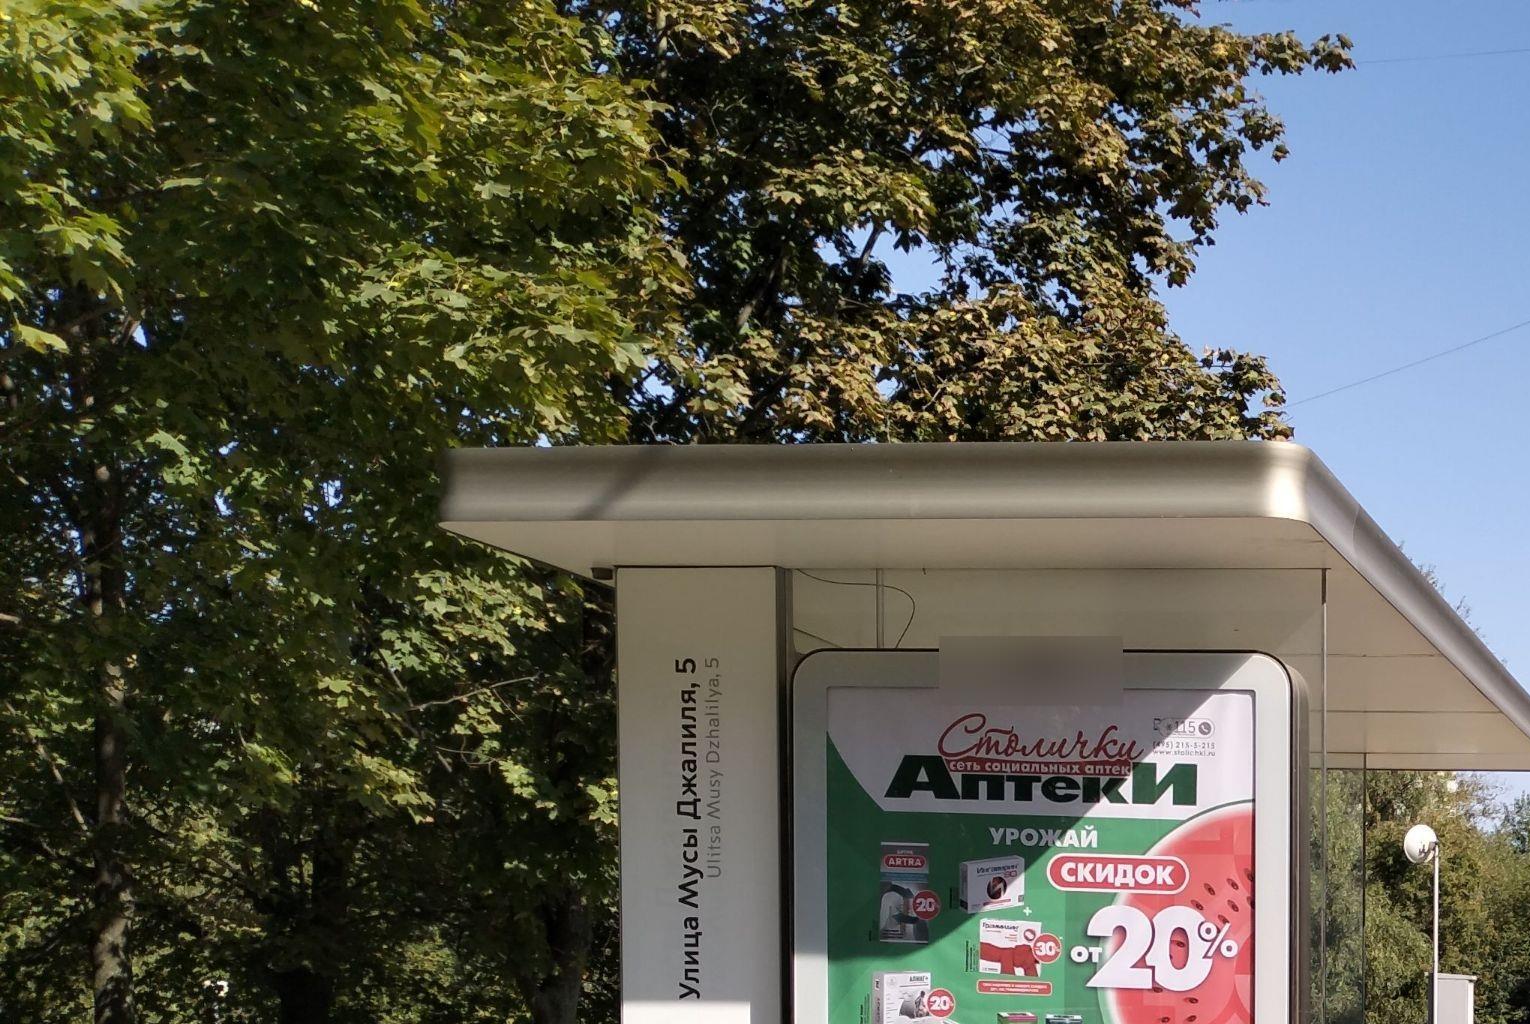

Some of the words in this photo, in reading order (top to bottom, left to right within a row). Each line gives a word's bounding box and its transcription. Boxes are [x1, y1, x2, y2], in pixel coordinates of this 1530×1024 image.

[675, 658, 696, 674] 5
[704, 657, 719, 668] 5
[704, 674, 724, 763] Dzhalilya,
[938, 713, 1144, 761] Столички
[676, 682, 701, 820] Джалиля,
[950, 760, 983, 773] сеть
[985, 761, 1081, 775] социальных
[1084, 764, 1130, 776] аптек
[706, 769, 724, 820] Musy
[706, 825, 721, 879] Ulitsa
[988, 825, 1098, 848] УРОЖАЙ
[678, 828, 703, 909] Мусы
[888, 857, 922, 867] ARTRA
[1060, 862, 1175, 887] СКИДОК
[679, 916, 703, 1000] Улица
[1070, 945, 1103, 964] от
[1085, 905, 1239, 992] 20%
